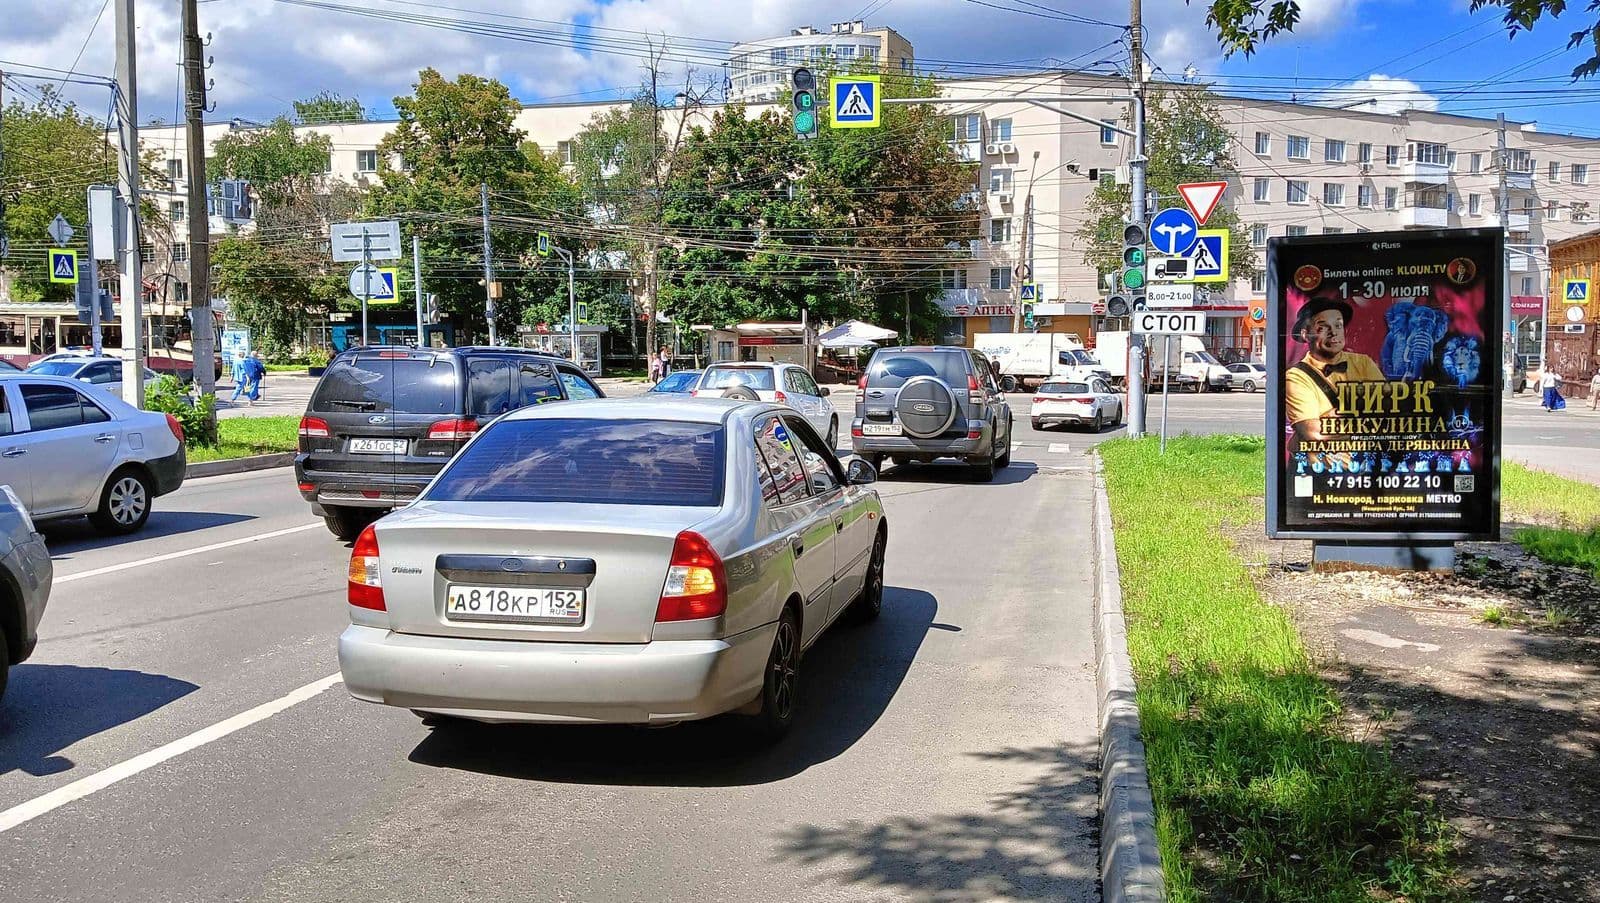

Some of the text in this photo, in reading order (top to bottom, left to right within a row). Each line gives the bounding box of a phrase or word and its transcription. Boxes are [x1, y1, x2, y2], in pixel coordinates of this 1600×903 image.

[1324, 264, 1447, 278] Билеты online: KLOUN.TV
[1391, 286, 1429, 297] июля
[974, 305, 1014, 315] АПТЕК
[1142, 315, 1196, 331] СТОП
[1336, 381, 1435, 416] ЦИРК
[1321, 416, 1447, 435] НИКУЛИНА
[1299, 439, 1471, 452] ВЛАДИМИРА ДЕРЯБКИНА
[1327, 475, 1441, 488] +7 915 100 22 10
[1313, 494, 1462, 505] Н. Новгород, парковка METRO
[454, 589, 577, 613] А818КР 152
